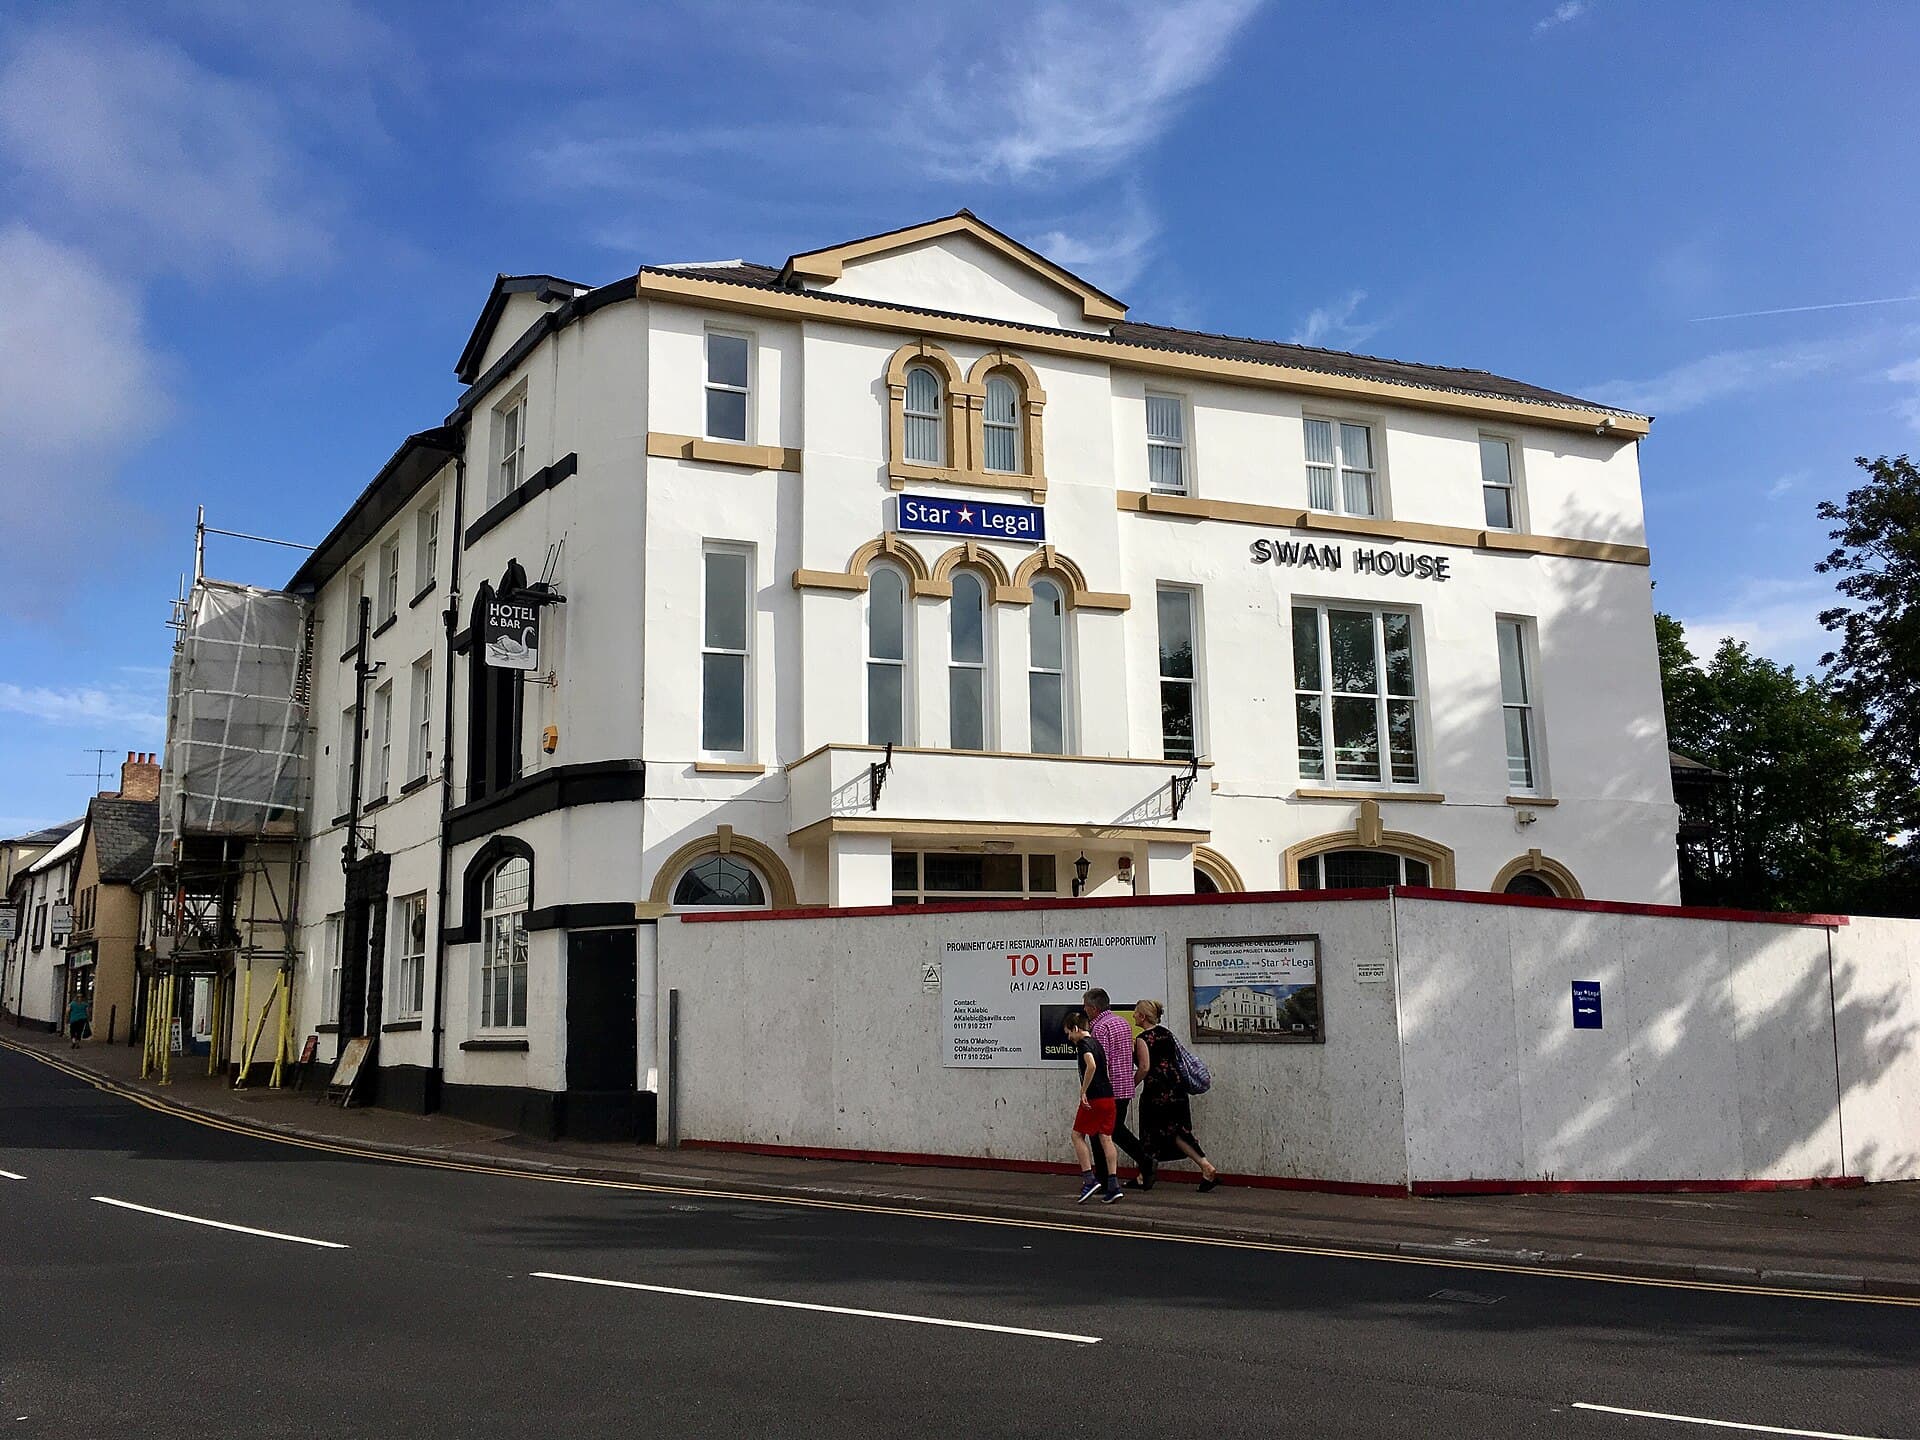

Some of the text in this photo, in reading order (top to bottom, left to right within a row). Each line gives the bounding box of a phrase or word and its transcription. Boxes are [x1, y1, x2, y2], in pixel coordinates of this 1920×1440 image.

[905, 502, 1036, 534] Star Legal
[1252, 538, 1451, 580] SWAN HOUSE
[490, 603, 535, 620] HOTEL
[489, 617, 521, 629] & BAR
[946, 941, 986, 952] PROMINENT
[987, 940, 1004, 950] CAFE
[1010, 938, 1053, 950] RESTAURANT
[1059, 938, 1074, 948] BAR
[1079, 937, 1104, 948] RETAIL
[1105, 935, 1157, 947] OPPORTUNITY
[1006, 952, 1094, 977] TO LET
[1261, 958, 1280, 968] Star
[1009, 982, 1025, 993] (A1
[1032, 981, 1045, 991] A2
[1051, 981, 1065, 991] A3
[1066, 980, 1090, 991] USE)
